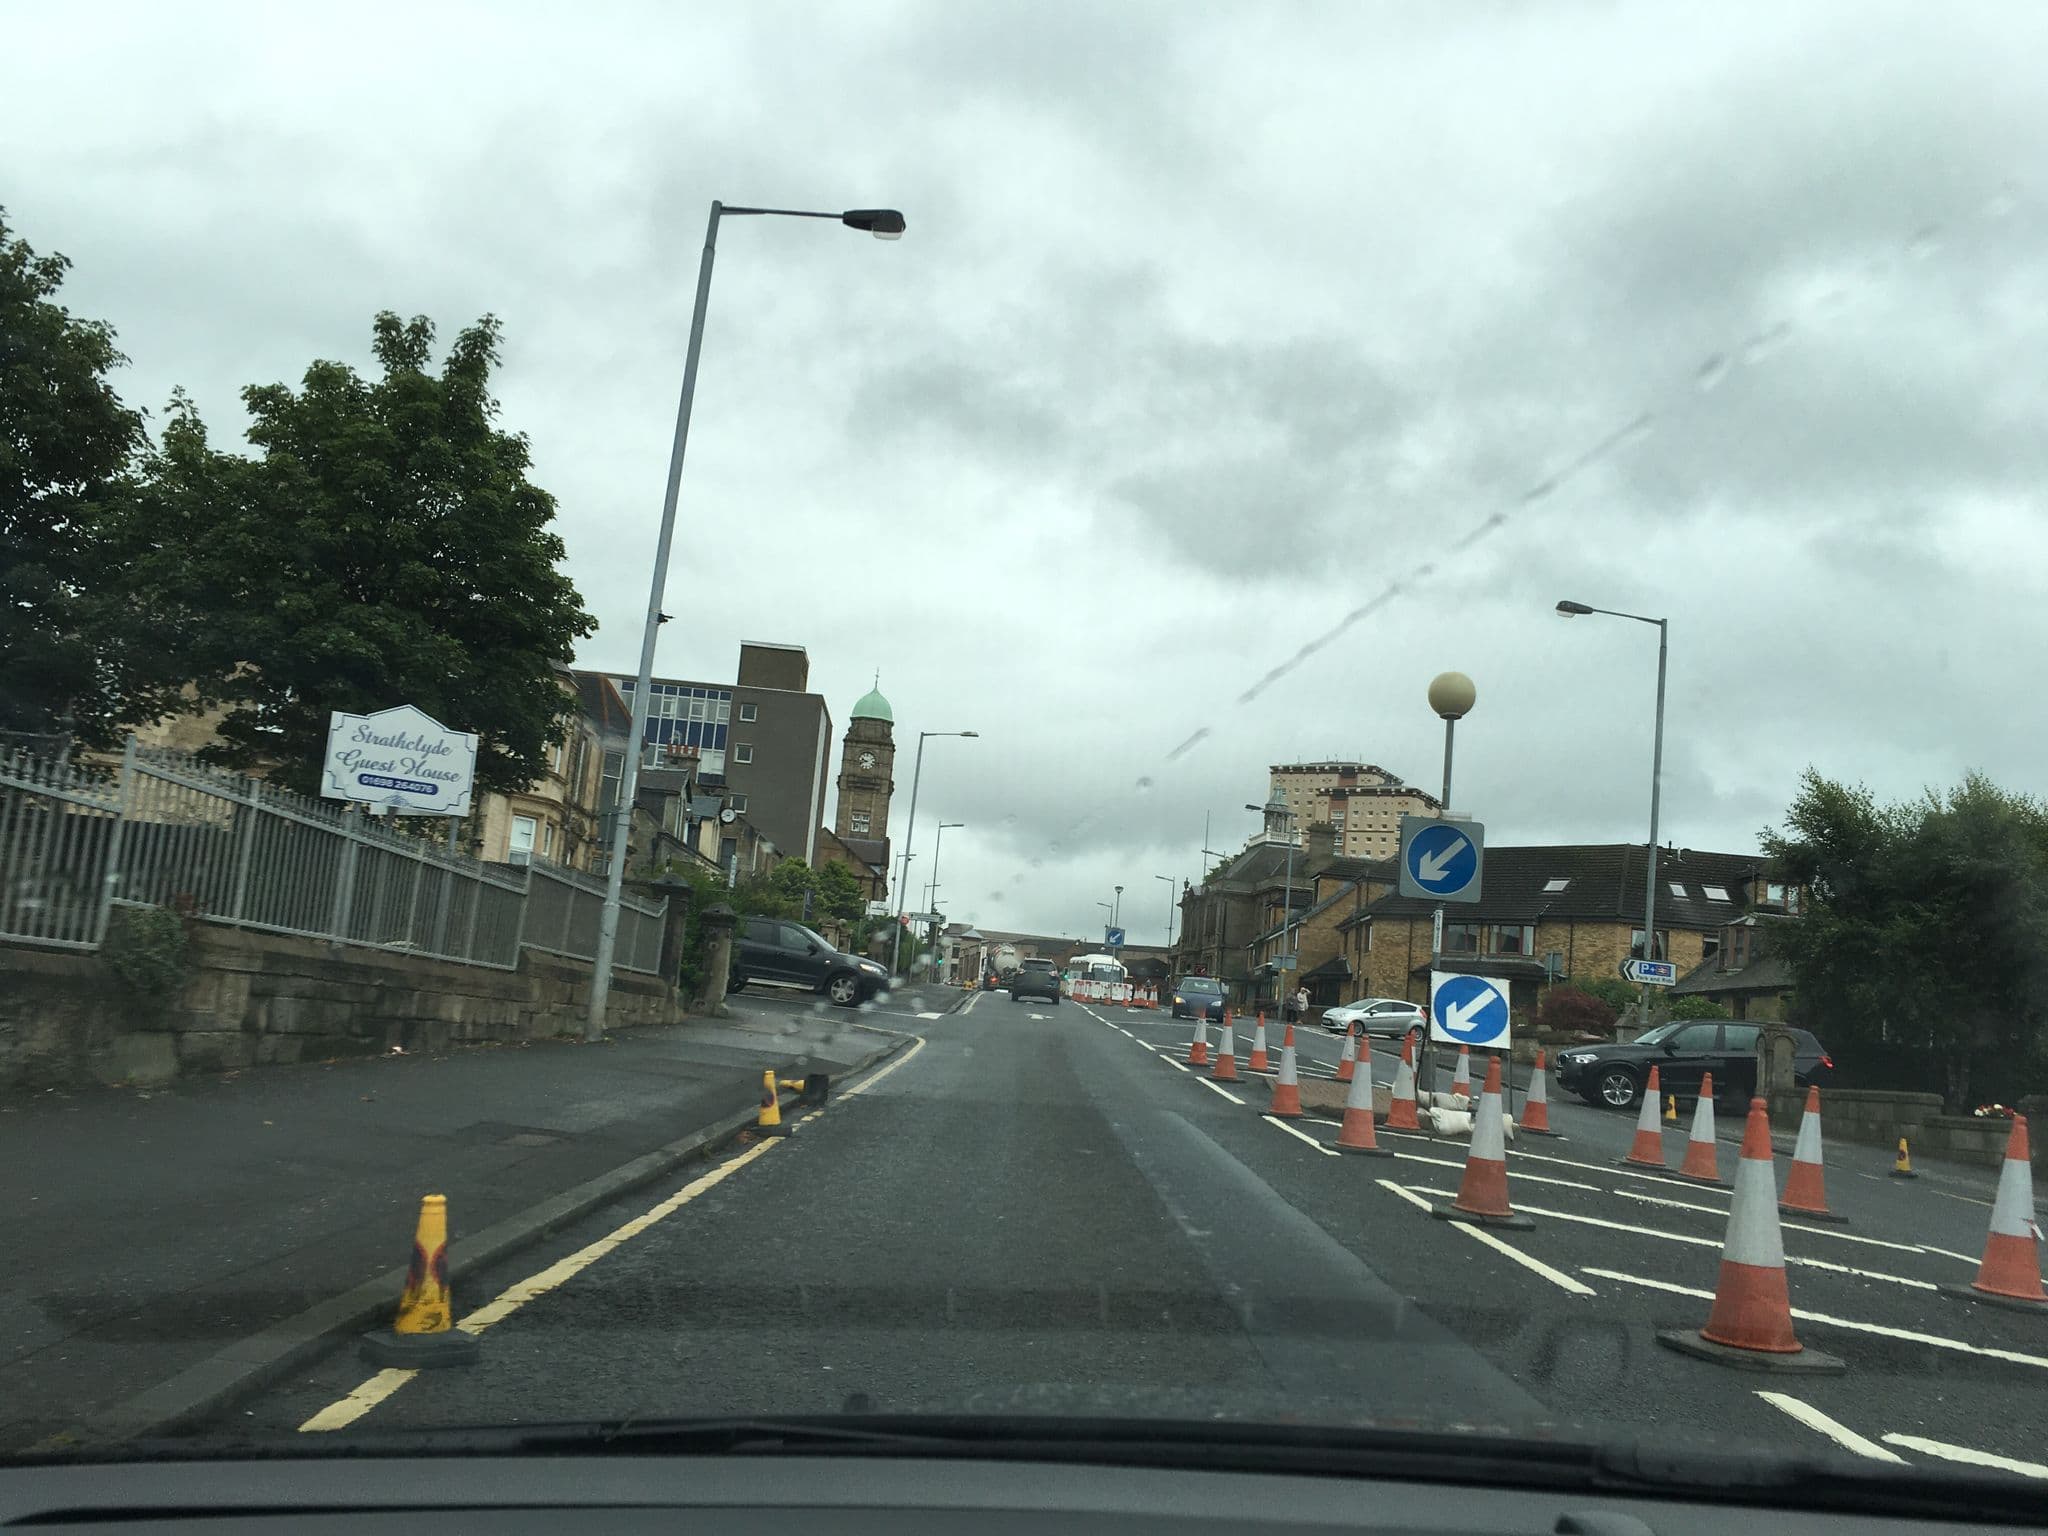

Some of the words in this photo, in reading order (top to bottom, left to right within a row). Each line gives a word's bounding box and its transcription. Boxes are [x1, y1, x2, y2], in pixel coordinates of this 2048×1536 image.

[352, 724, 452, 759] Strathclyde
[336, 749, 397, 773] Guest
[400, 757, 463, 783] House
